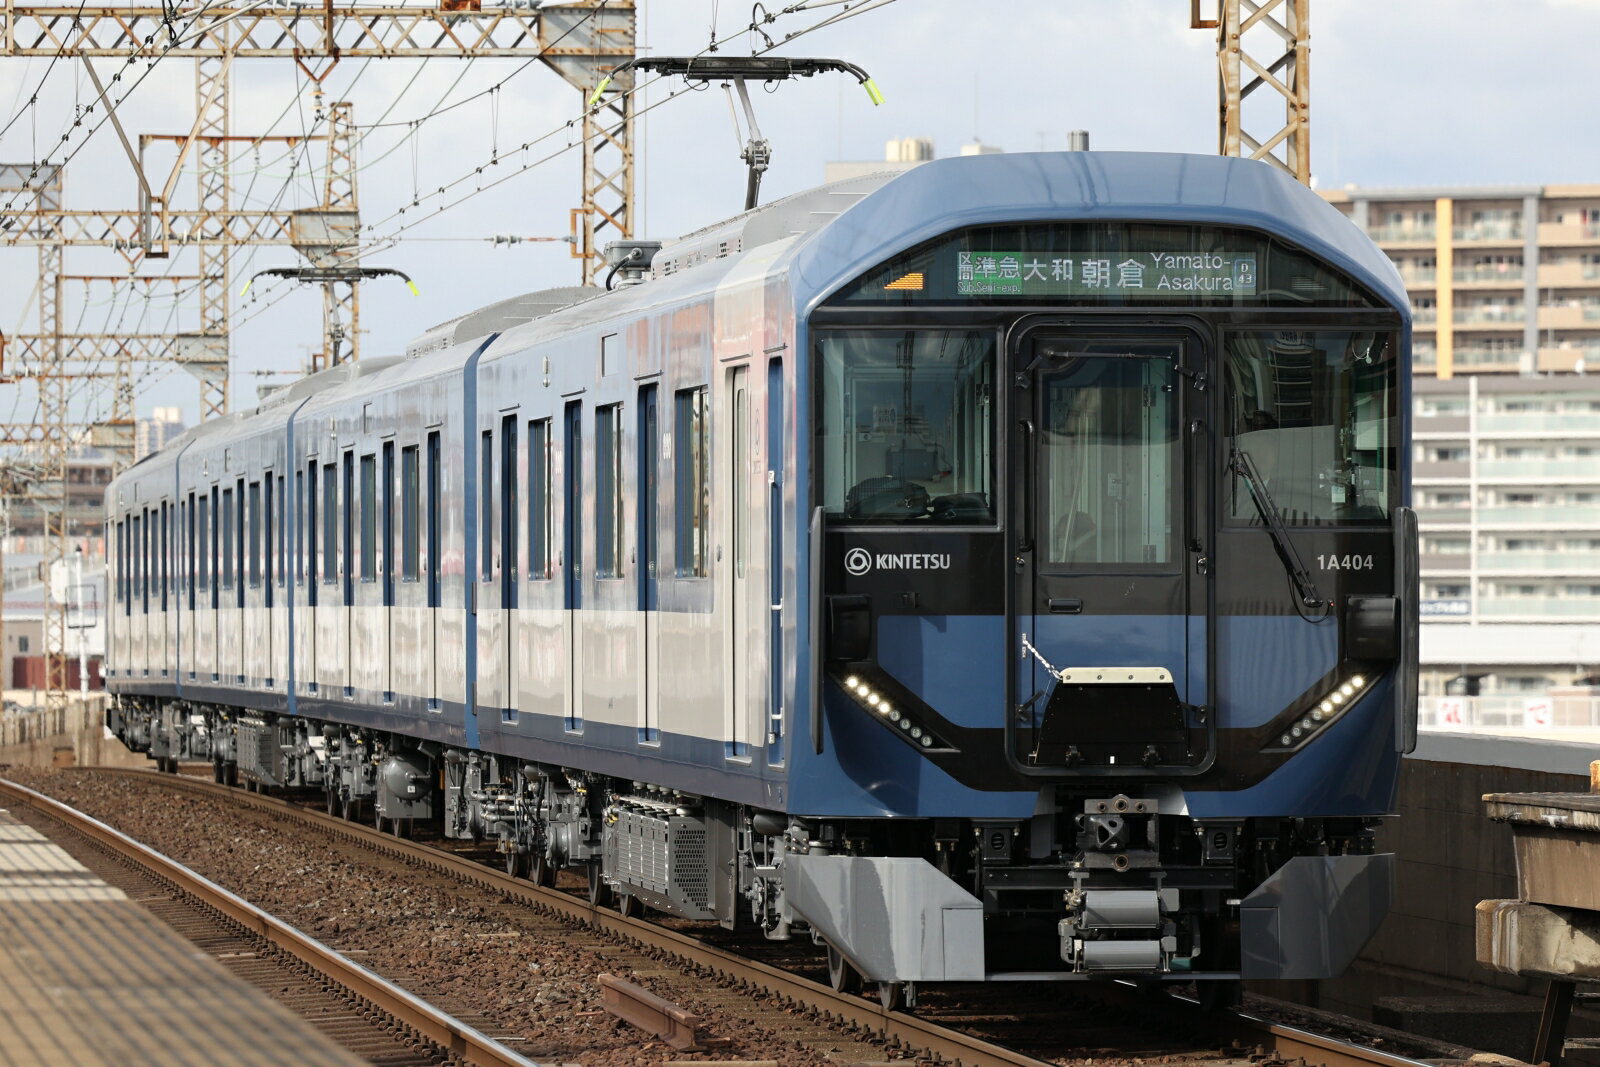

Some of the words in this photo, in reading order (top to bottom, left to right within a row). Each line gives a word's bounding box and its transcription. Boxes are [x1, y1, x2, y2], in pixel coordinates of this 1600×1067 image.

[958, 251, 973, 281] 区間
[975, 255, 1021, 279] 準急
[1150, 252, 1231, 269] Yamato-
[1023, 257, 1146, 289] 大和朝倉
[1156, 274, 1234, 290] Asakura
[876, 553, 951, 570] KINTETSU
[1317, 554, 1374, 570] 1A404
